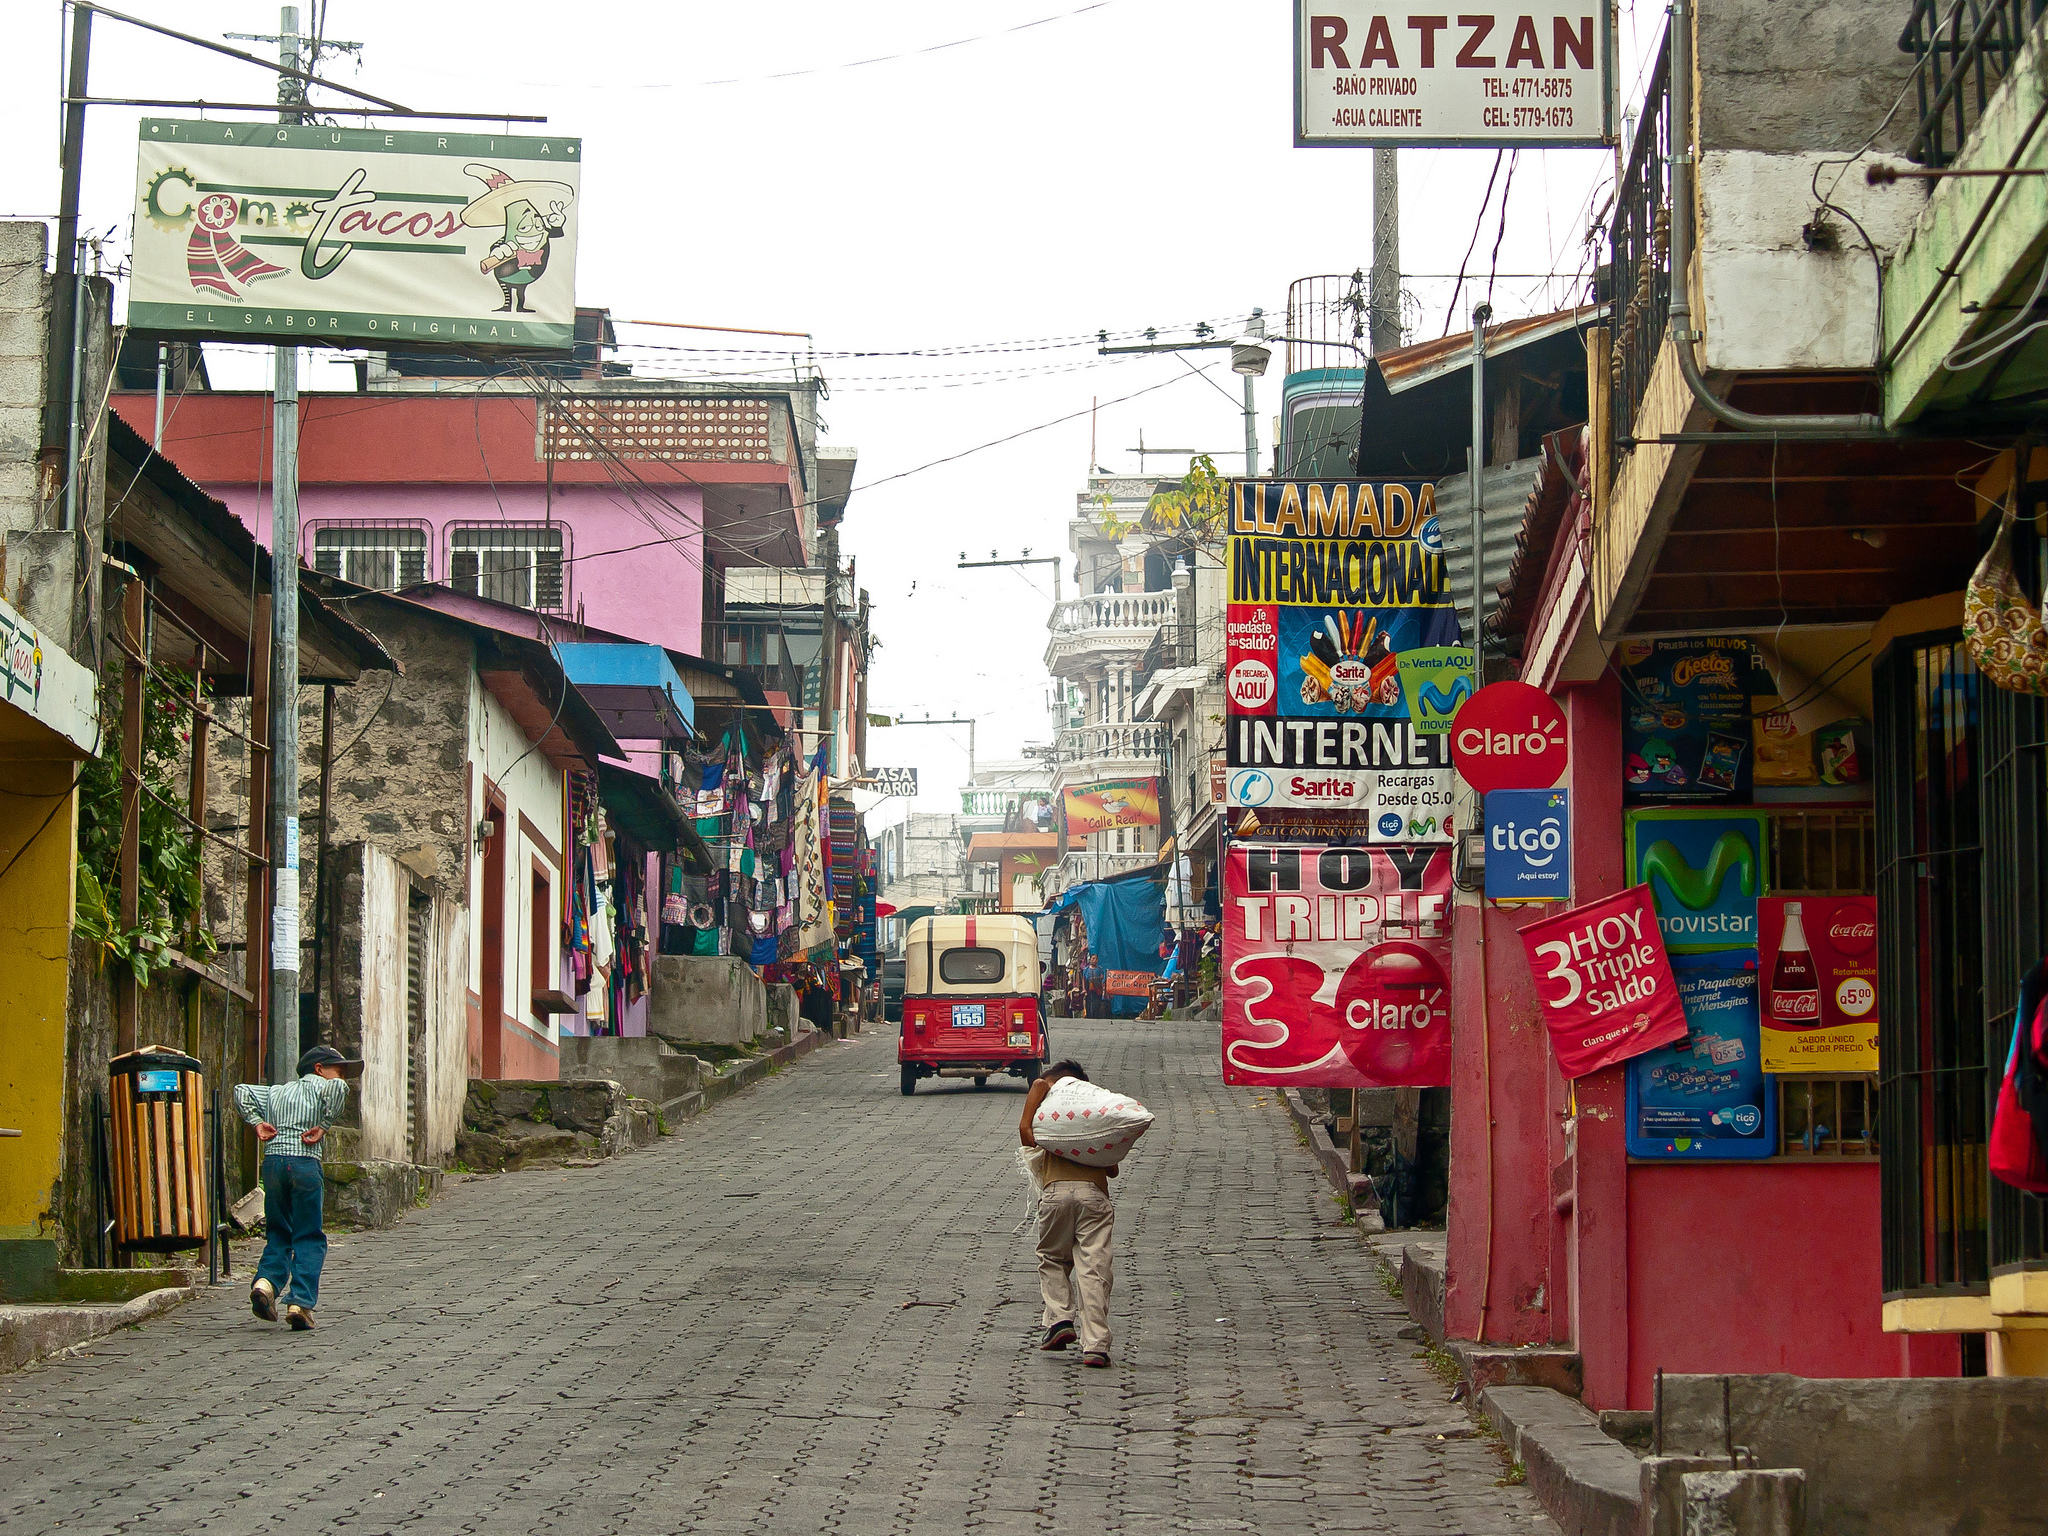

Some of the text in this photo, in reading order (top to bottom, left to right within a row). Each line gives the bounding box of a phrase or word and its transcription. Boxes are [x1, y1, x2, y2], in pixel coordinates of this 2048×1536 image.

[1310, 15, 1594, 69] RATZAN
[1370, 77, 1417, 96] PRIVADO
[1483, 77, 1573, 98] TEL: 4771-5875
[1369, 108, 1422, 127] CALIENTE
[1483, 107, 1573, 127] CEL: 5779-1673
[170, 124, 550, 154] TAQUERIA
[187, 310, 518, 338] EL SABOR ORIGINAL
[1252, 608, 1267, 623] ¿Te
[1228, 620, 1272, 636] quedaste
[1228, 634, 1276, 650] sin saldo?
[1658, 641, 1688, 650] PRUEBA
[1706, 637, 1747, 650] NUEVOS
[1335, 665, 1365, 678] Sarita
[1399, 661, 1410, 669] De
[1411, 658, 1442, 668] Venta
[1673, 652, 1732, 686] Cheetos
[1242, 669, 1269, 678] RECARGA
[1235, 678, 1268, 700] AQUÍ
[1457, 721, 1555, 756] Claro
[1290, 776, 1354, 797] Sarita
[1378, 774, 1435, 790] Recargas
[1378, 792, 1418, 806] Desde
[1246, 847, 1438, 893] HOY
[1235, 894, 1445, 943] TRIPLE
[1568, 907, 1643, 961] HOY
[1579, 943, 1656, 985] Triple
[1832, 967, 1876, 976] Retornable
[1534, 940, 1582, 1009] 3
[1585, 975, 1657, 1016] Saldo
[1684, 990, 1721, 1004] Internet
[1698, 996, 1749, 1012] Mensajitos
[954, 1013, 982, 1025] 155
[1345, 990, 1440, 1030] Claro
[1582, 1035, 1605, 1048] Claro
[1605, 1029, 1621, 1041] que
[1797, 1033, 1855, 1044] SABOR ÚNICO
[1788, 1044, 1864, 1053] AL MEJOR PRECIO
